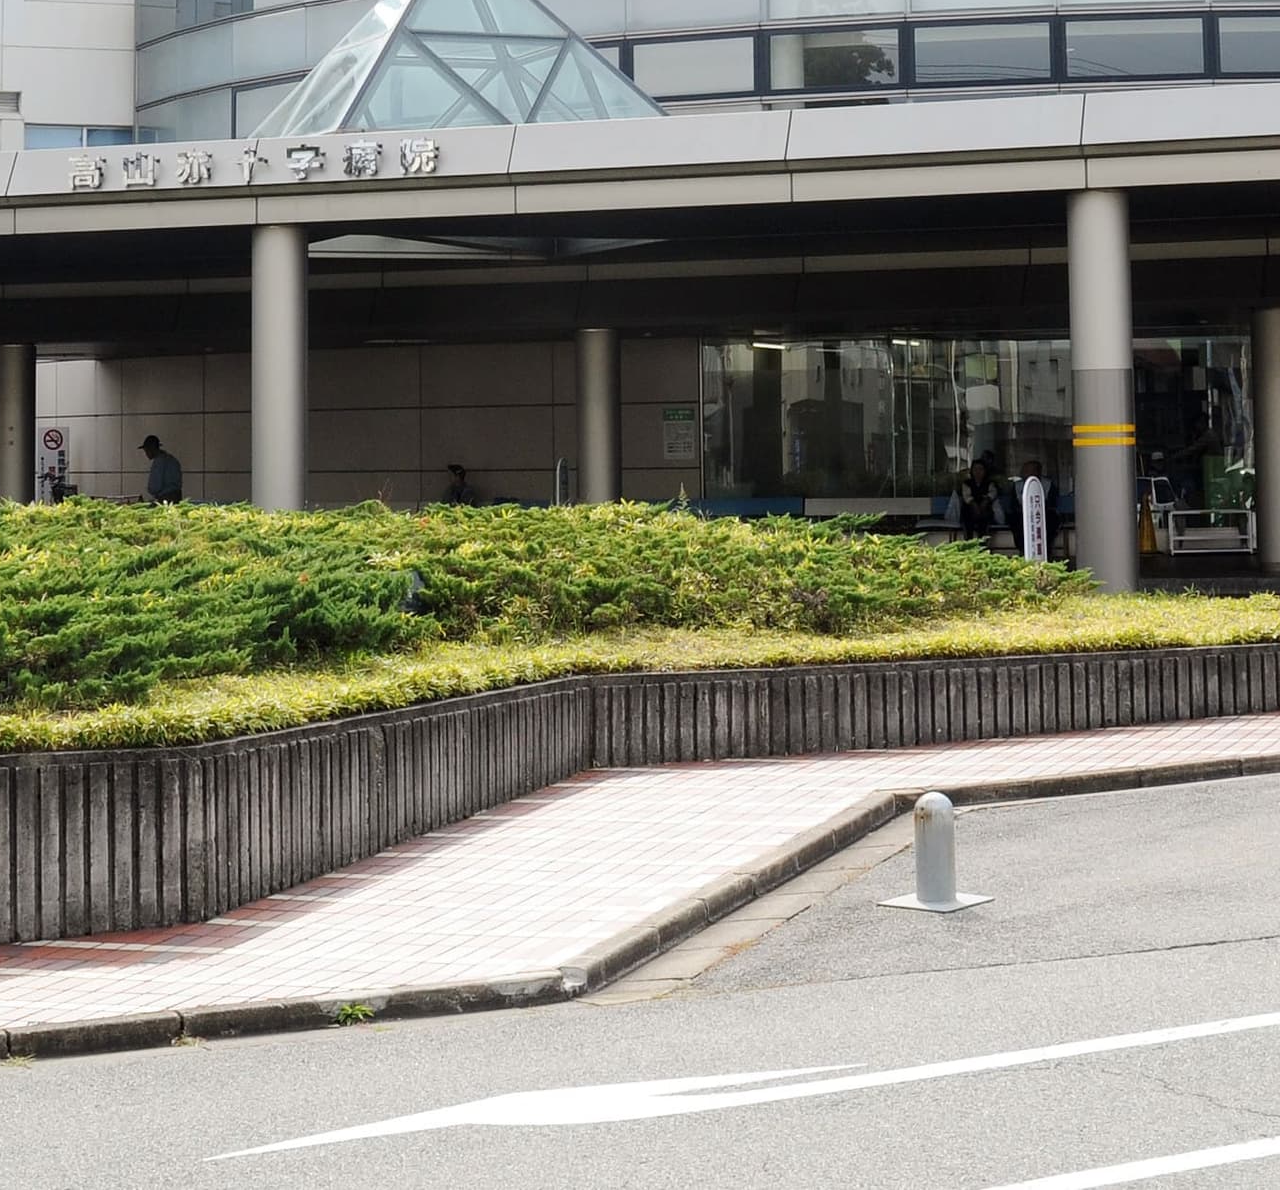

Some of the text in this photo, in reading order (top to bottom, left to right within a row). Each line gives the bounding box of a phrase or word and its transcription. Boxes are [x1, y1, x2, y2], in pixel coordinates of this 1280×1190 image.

[69, 137, 440, 191] 高山赤十字病院
